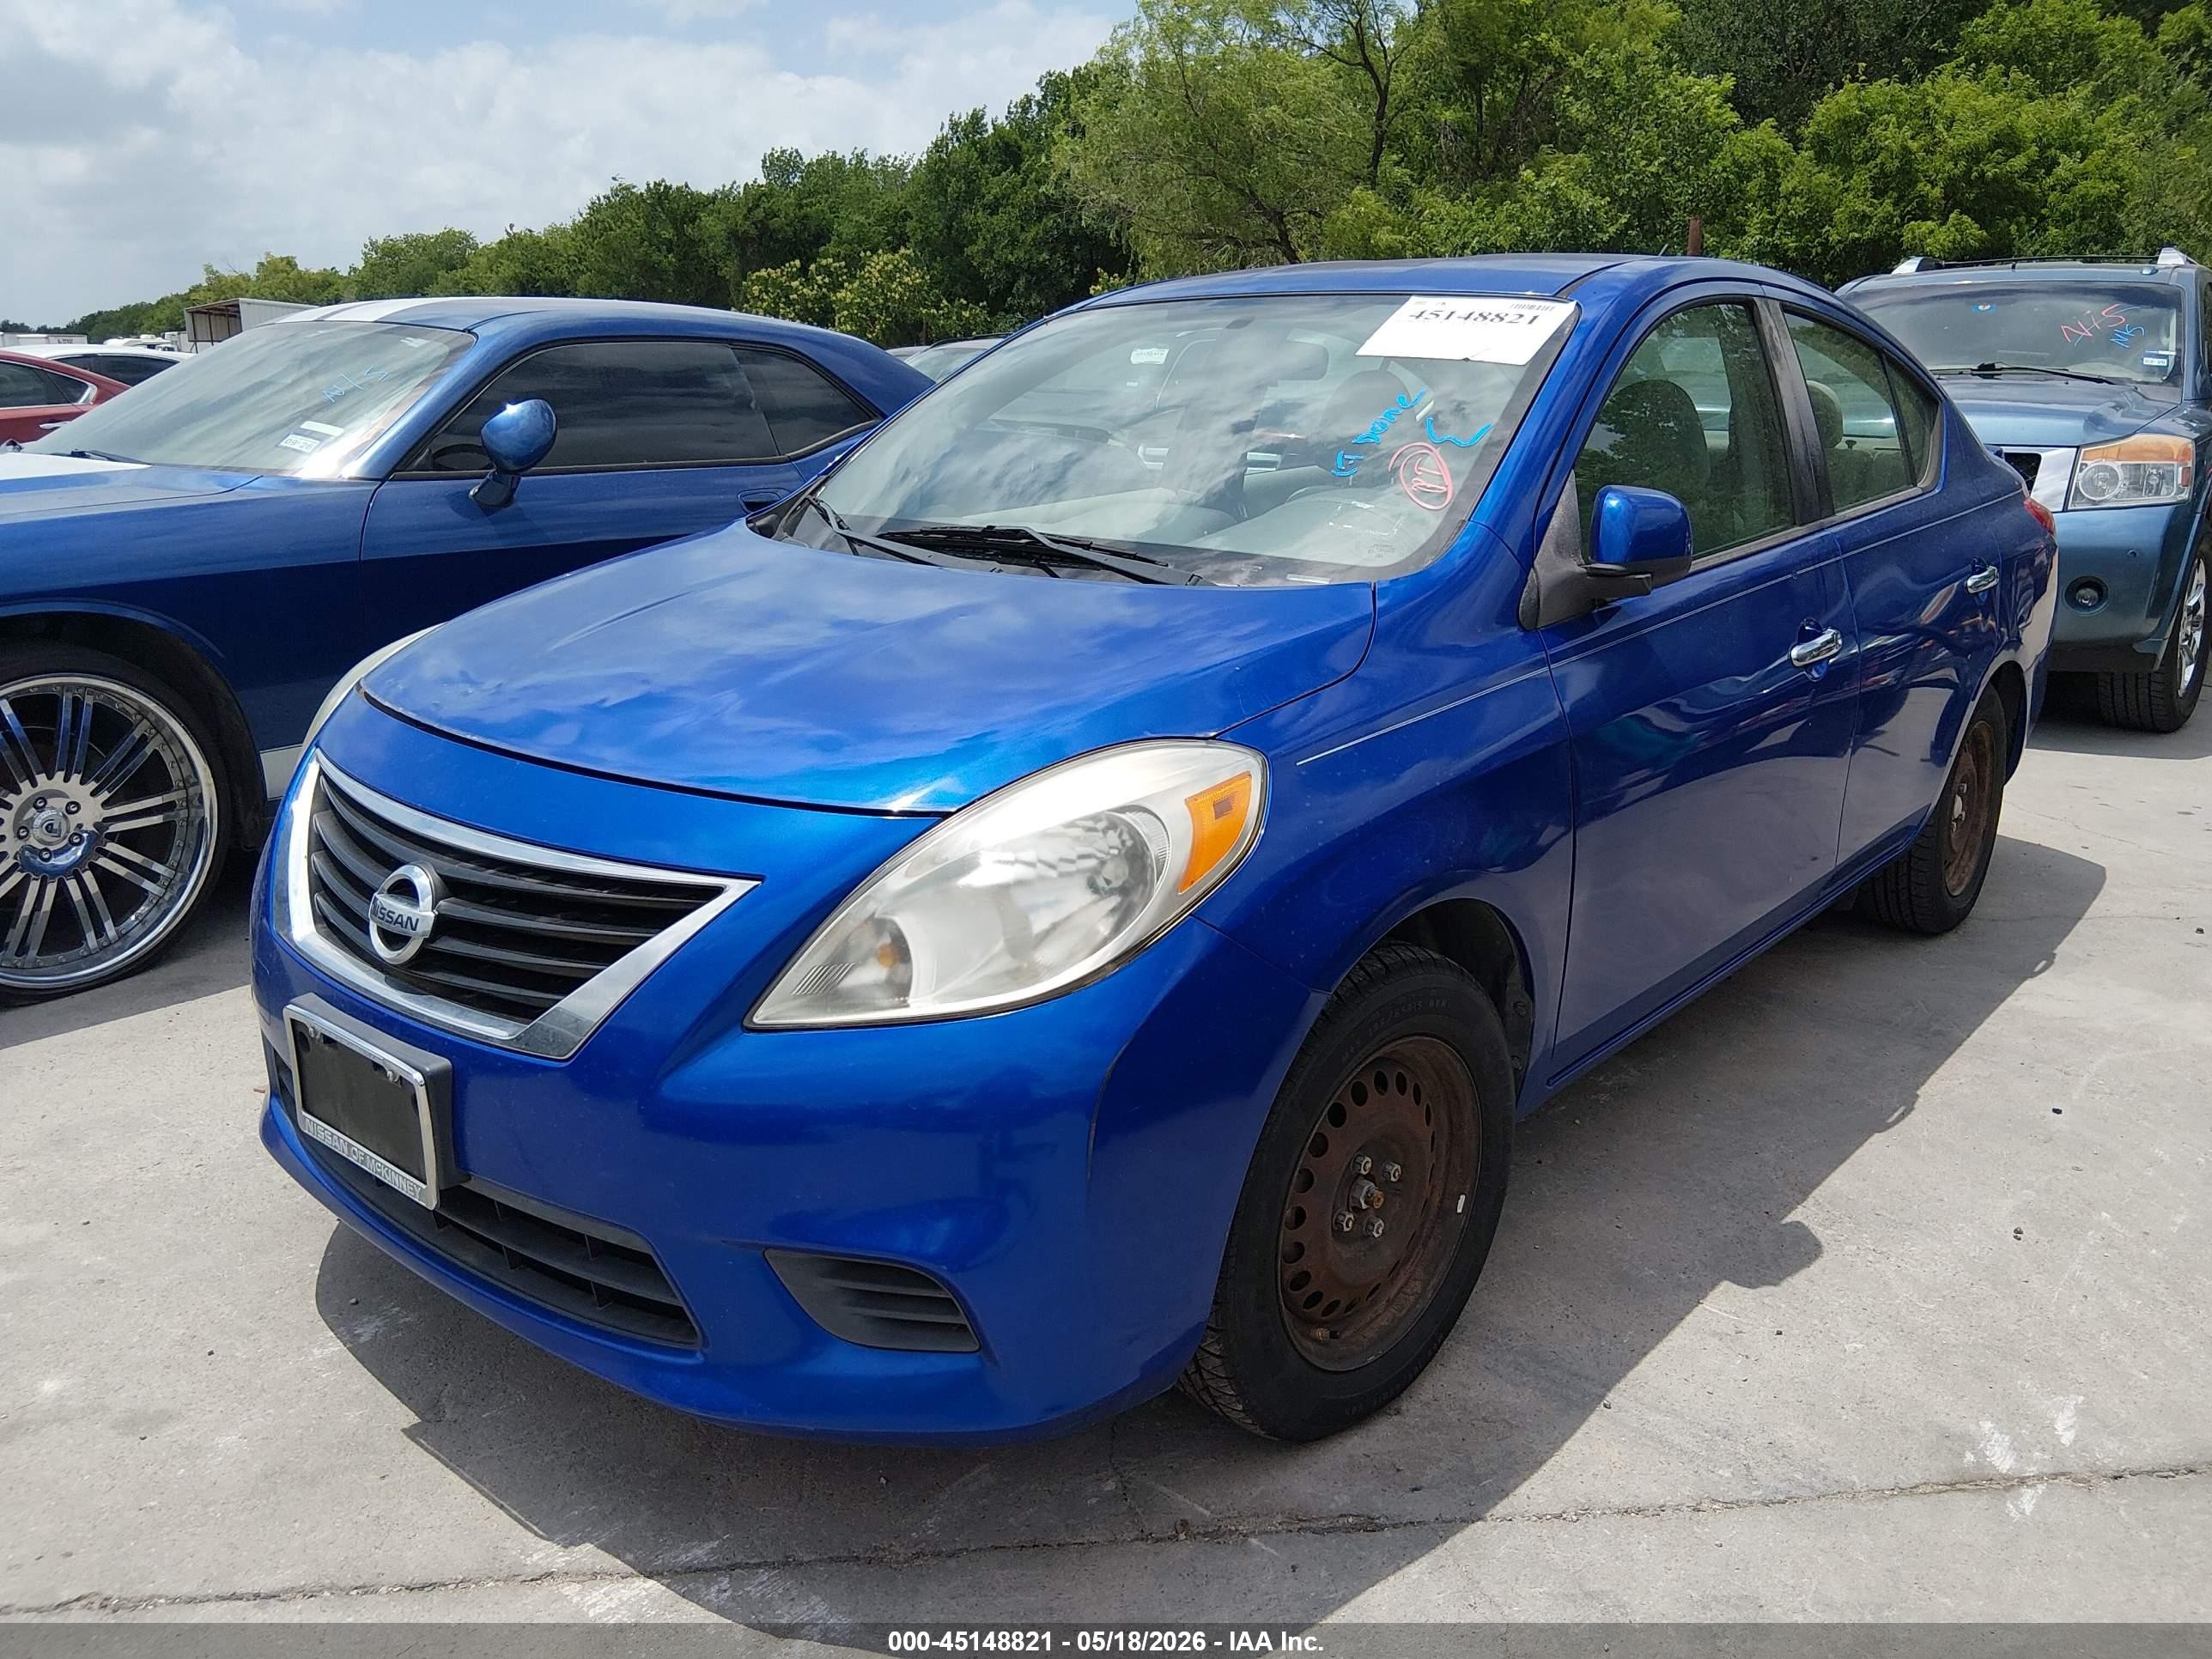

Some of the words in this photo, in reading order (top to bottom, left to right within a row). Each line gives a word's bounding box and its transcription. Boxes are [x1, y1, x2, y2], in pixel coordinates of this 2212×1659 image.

[1409, 310, 1540, 325] 45148821
[372, 900, 420, 932] NISSAN
[305, 1118, 349, 1156] NISSAN
[350, 1146, 365, 1163] OF
